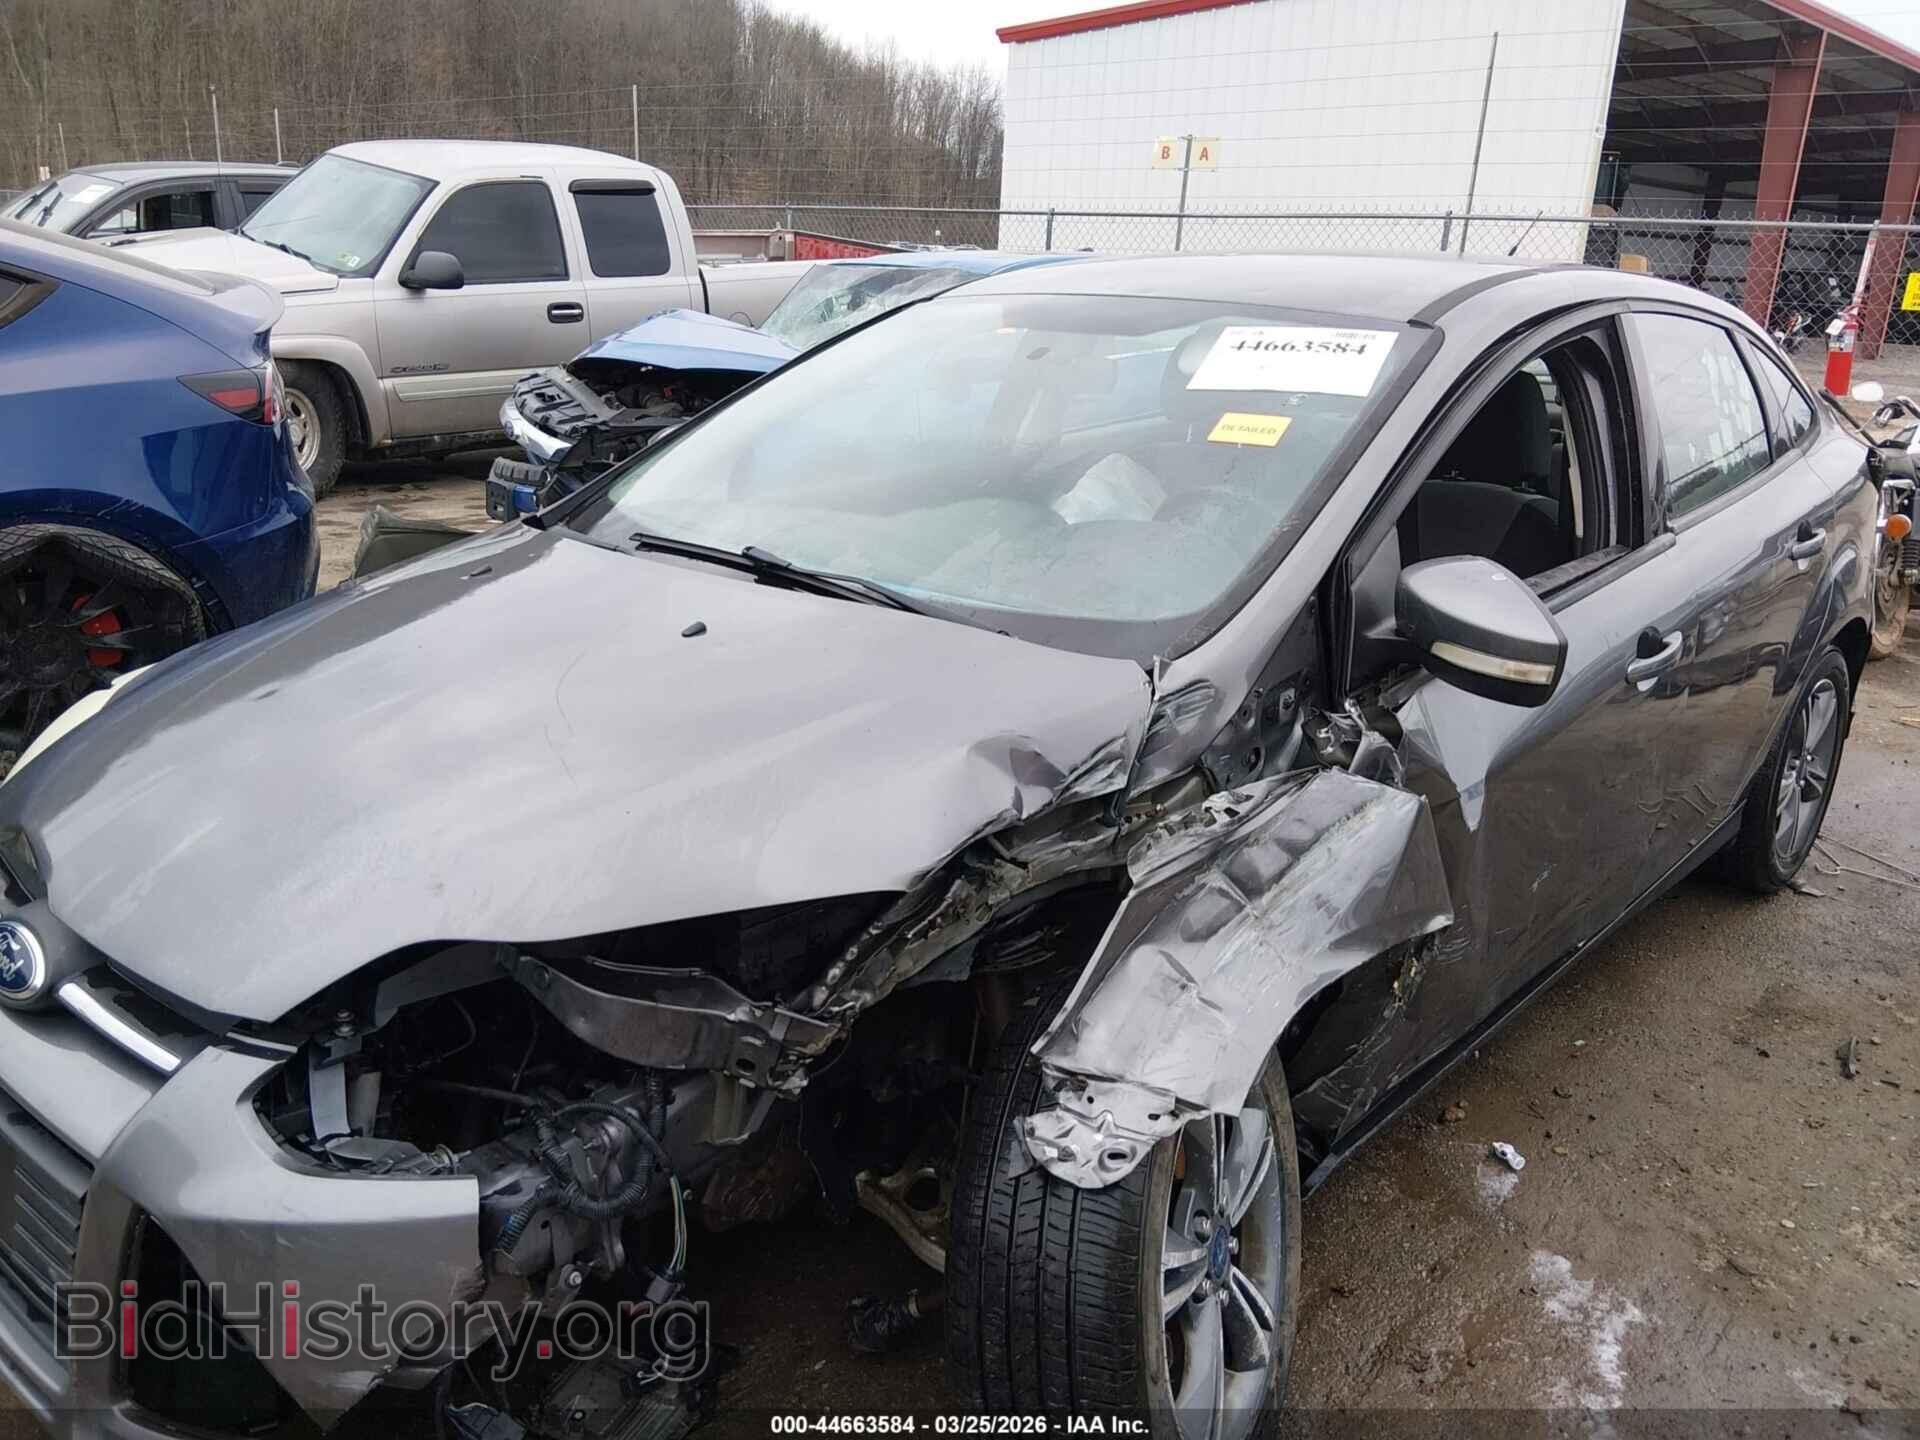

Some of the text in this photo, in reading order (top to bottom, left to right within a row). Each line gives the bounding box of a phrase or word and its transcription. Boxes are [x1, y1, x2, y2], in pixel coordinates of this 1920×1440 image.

[1161, 145, 1171, 160] B
[1199, 146, 1209, 161] A
[1230, 338, 1367, 355] 44663584
[1221, 423, 1278, 436] DETAILED
